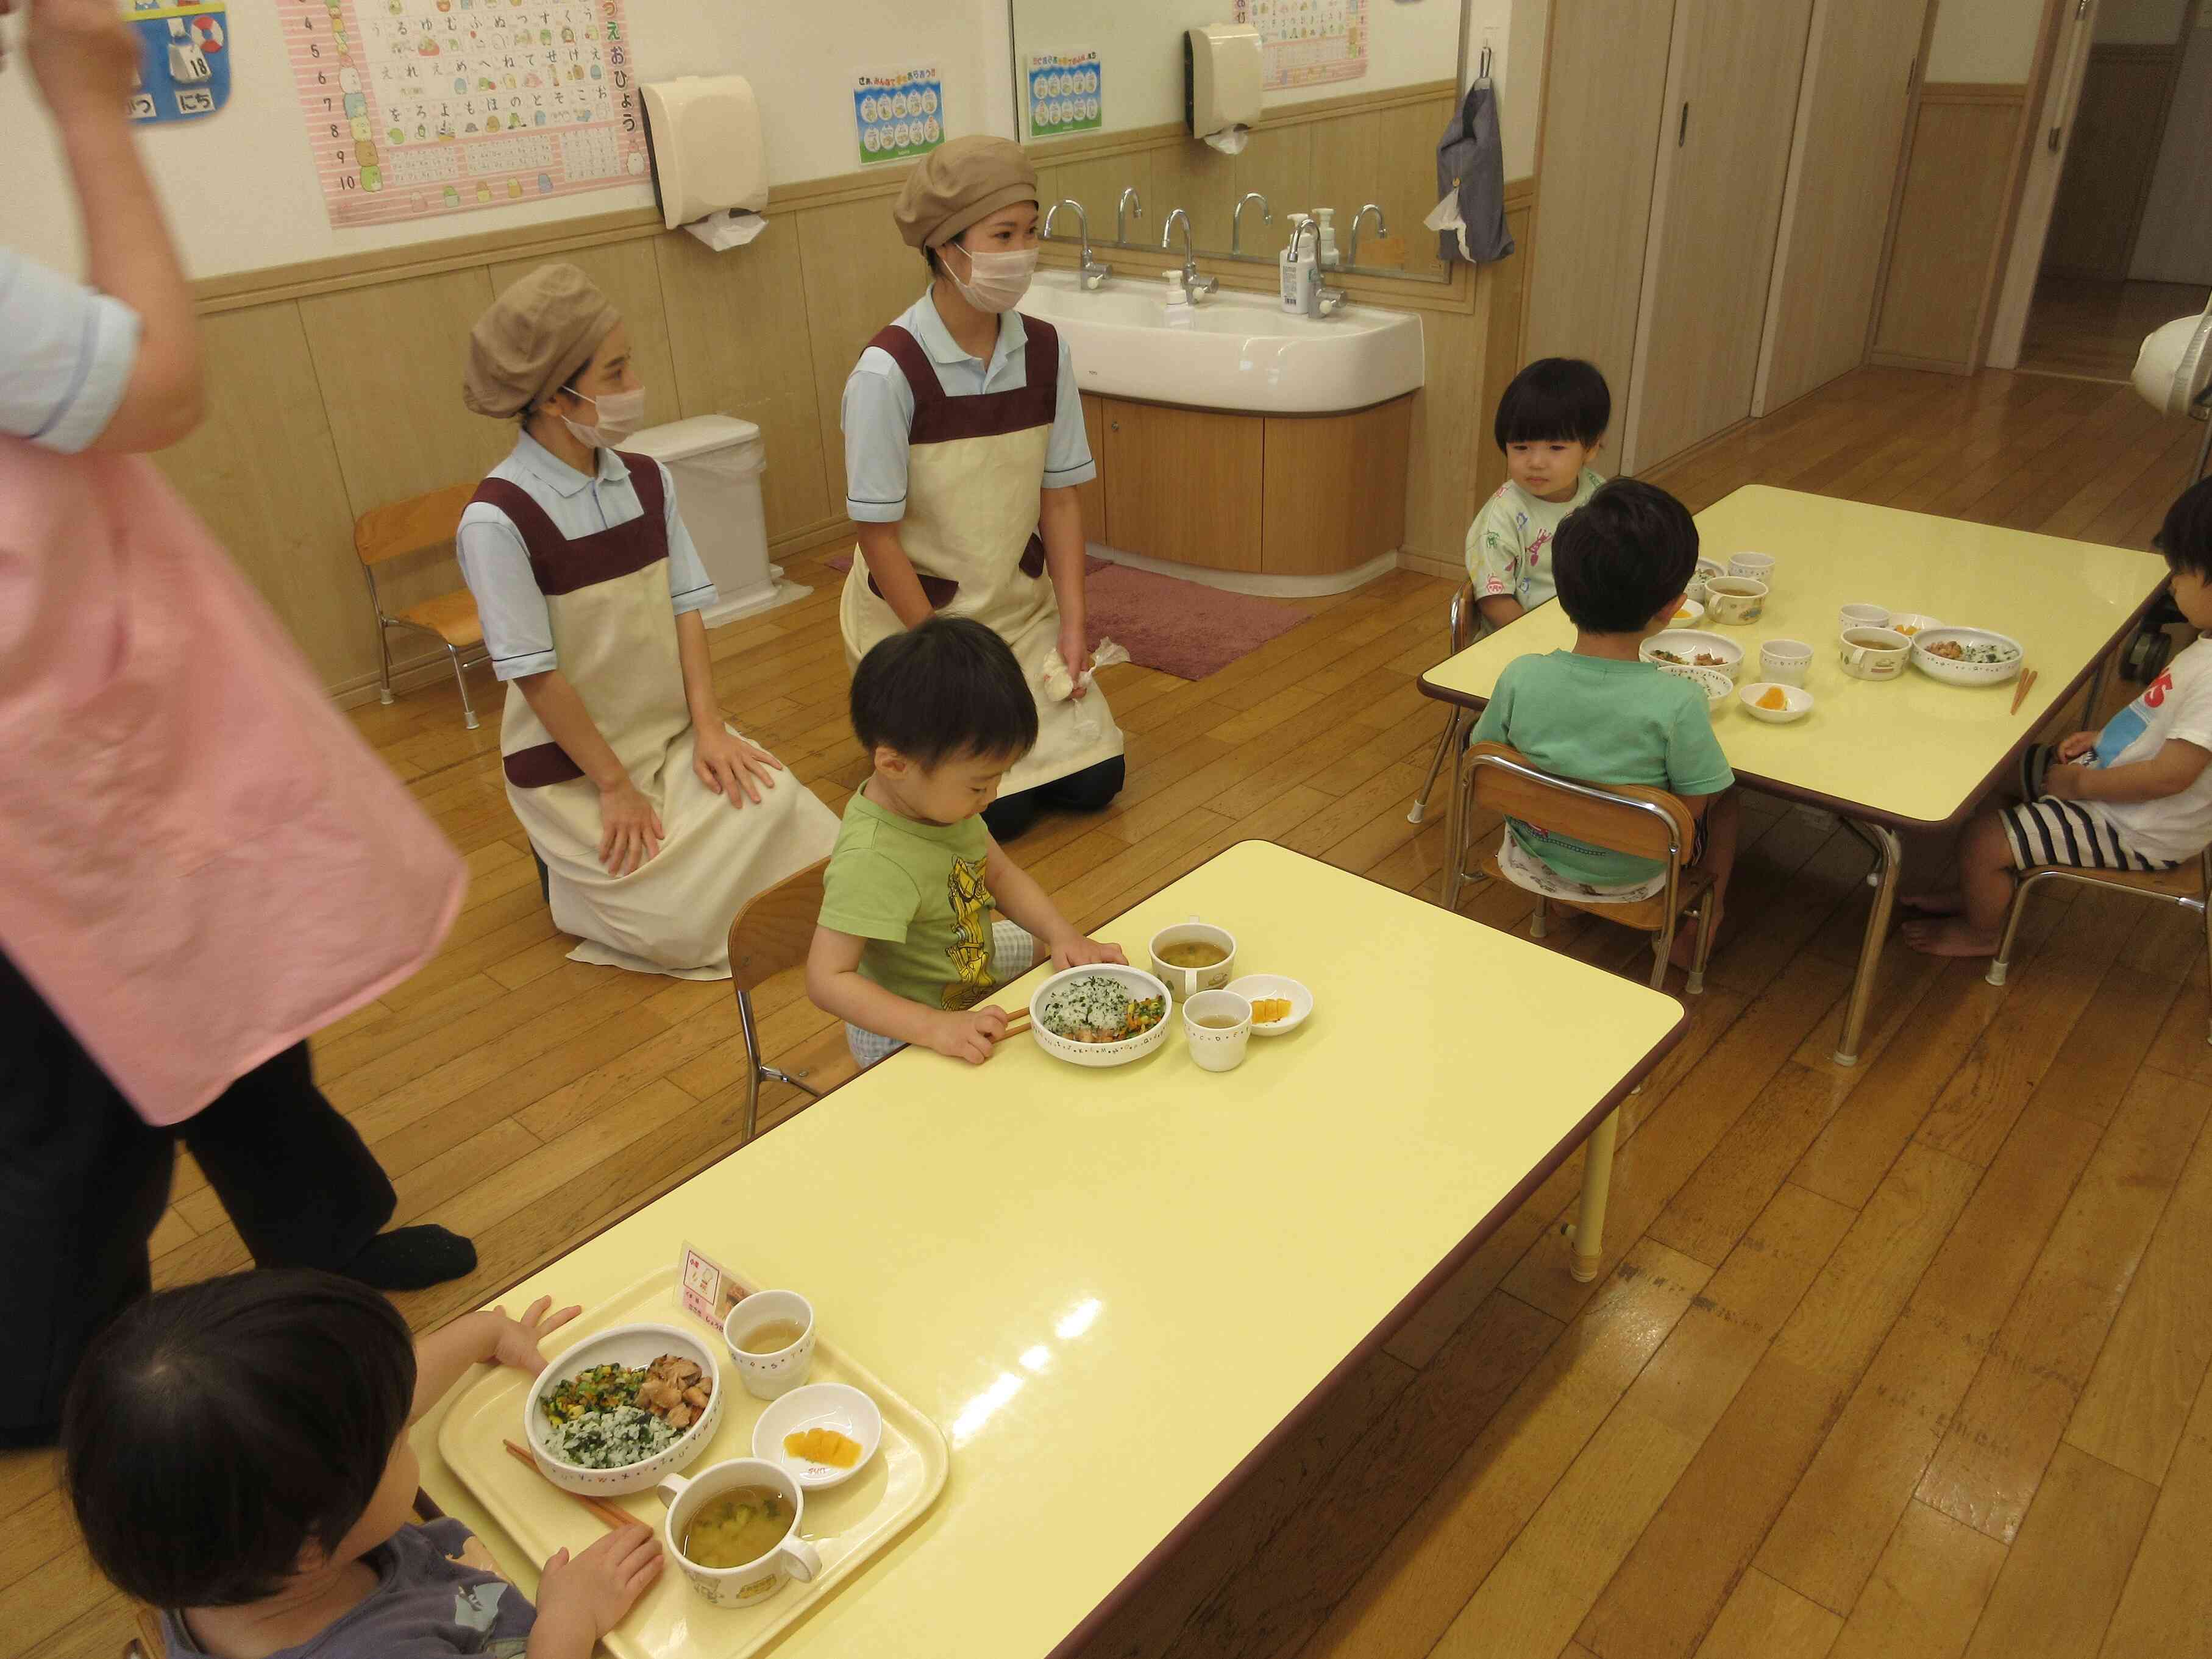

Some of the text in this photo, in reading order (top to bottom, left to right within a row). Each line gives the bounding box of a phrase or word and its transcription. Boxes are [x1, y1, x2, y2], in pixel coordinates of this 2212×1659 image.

[304, 16, 313, 30] 4
[397, 21, 408, 35] る
[421, 19, 433, 30] ゆ
[494, 16, 507, 29] ぬ
[517, 15, 527, 24] つ
[540, 11, 550, 24] す
[564, 9, 571, 23] く
[310, 44, 320, 59] 5
[190, 58, 207, 77] 18
[405, 63, 419, 79] れ
[503, 55, 516, 68] ね
[525, 54, 535, 66] て
[546, 50, 557, 63] せ
[569, 48, 578, 61] け
[590, 47, 601, 60] え
[318, 71, 327, 84] 6
[180, 93, 211, 111] にち
[323, 98, 332, 112] 7
[416, 105, 427, 118] ろ
[440, 102, 450, 117] よ
[464, 101, 475, 115] も
[486, 97, 499, 112] は
[510, 96, 521, 107] の
[533, 94, 542, 106] と
[555, 92, 564, 104] そ
[578, 90, 586, 101] こ
[597, 87, 608, 99] お
[330, 124, 339, 138] 8
[336, 151, 345, 164] 9
[340, 175, 355, 191] 10
